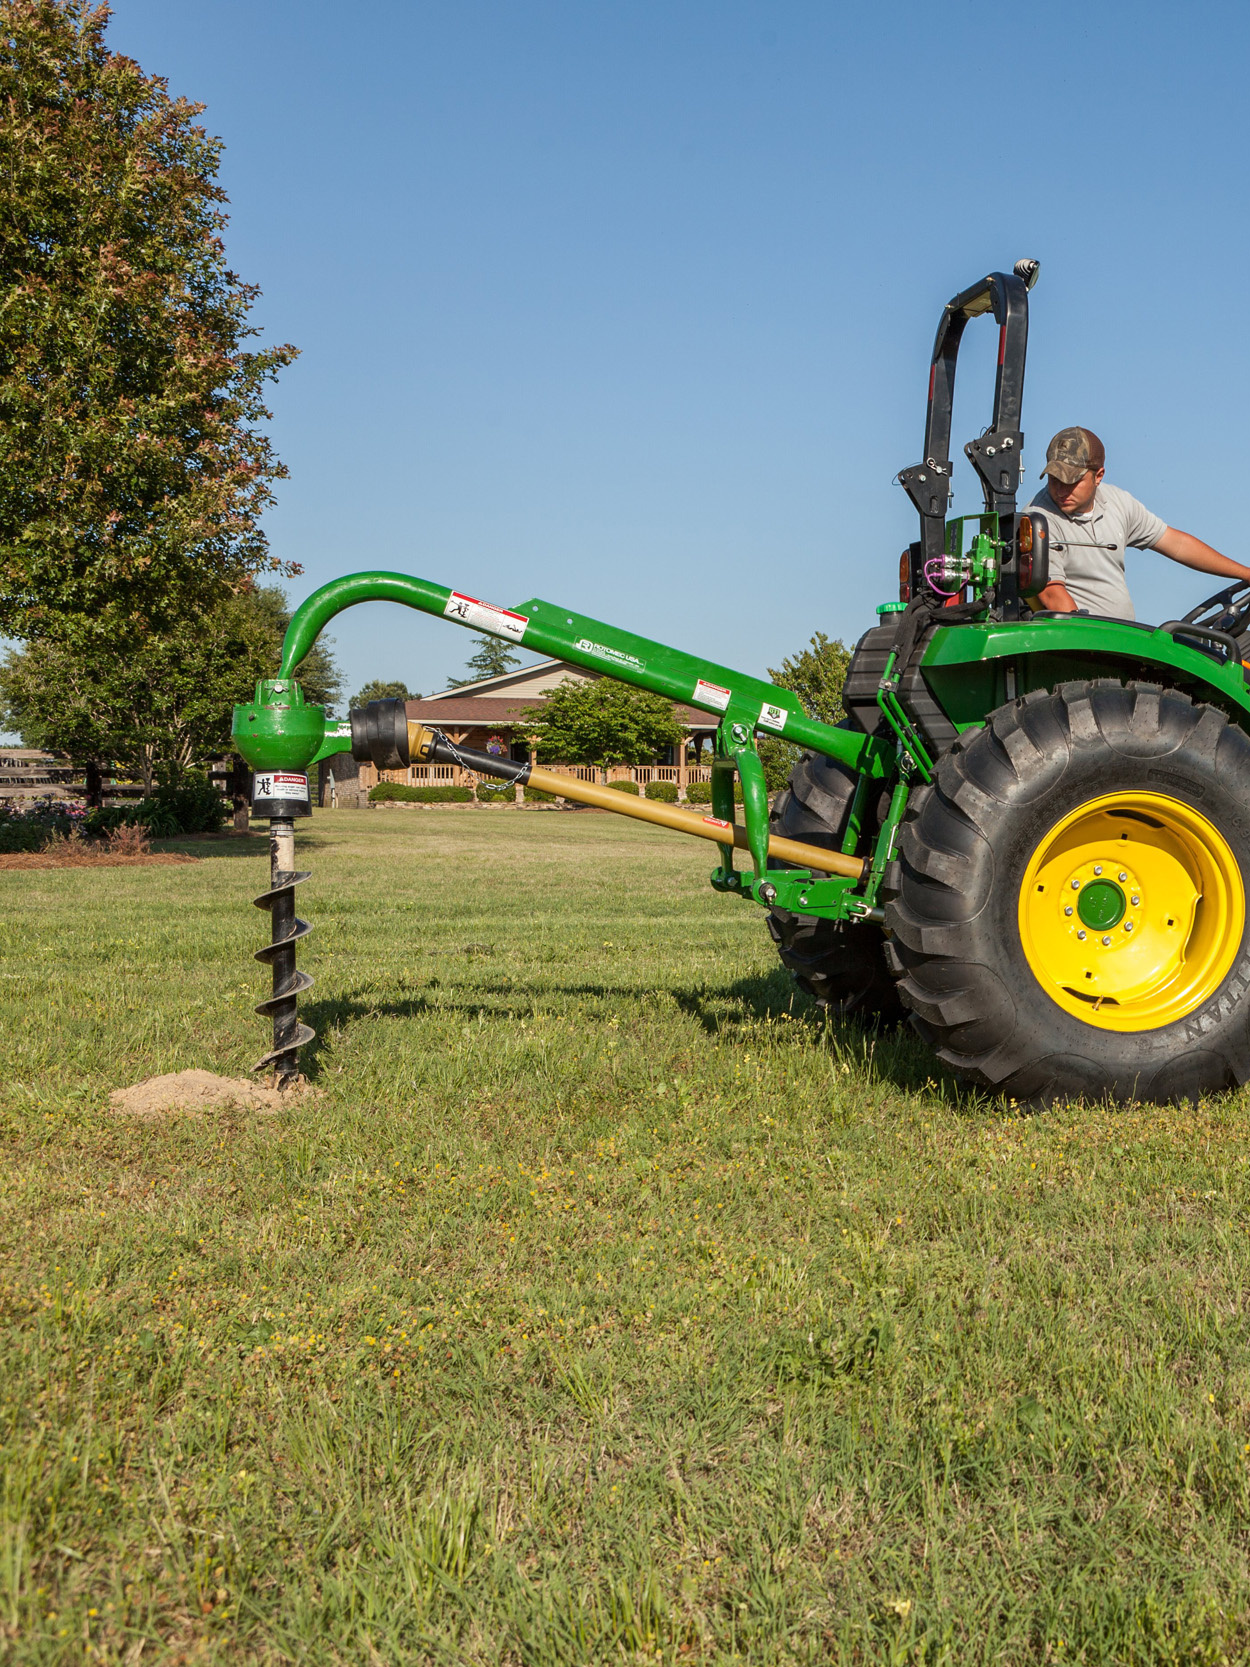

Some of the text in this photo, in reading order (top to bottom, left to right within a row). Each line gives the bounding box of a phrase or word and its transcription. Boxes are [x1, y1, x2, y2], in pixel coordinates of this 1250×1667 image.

[594, 643, 626, 659] ROTOMEC
[626, 655, 640, 664] USA
[284, 776, 304, 784] DANGER
